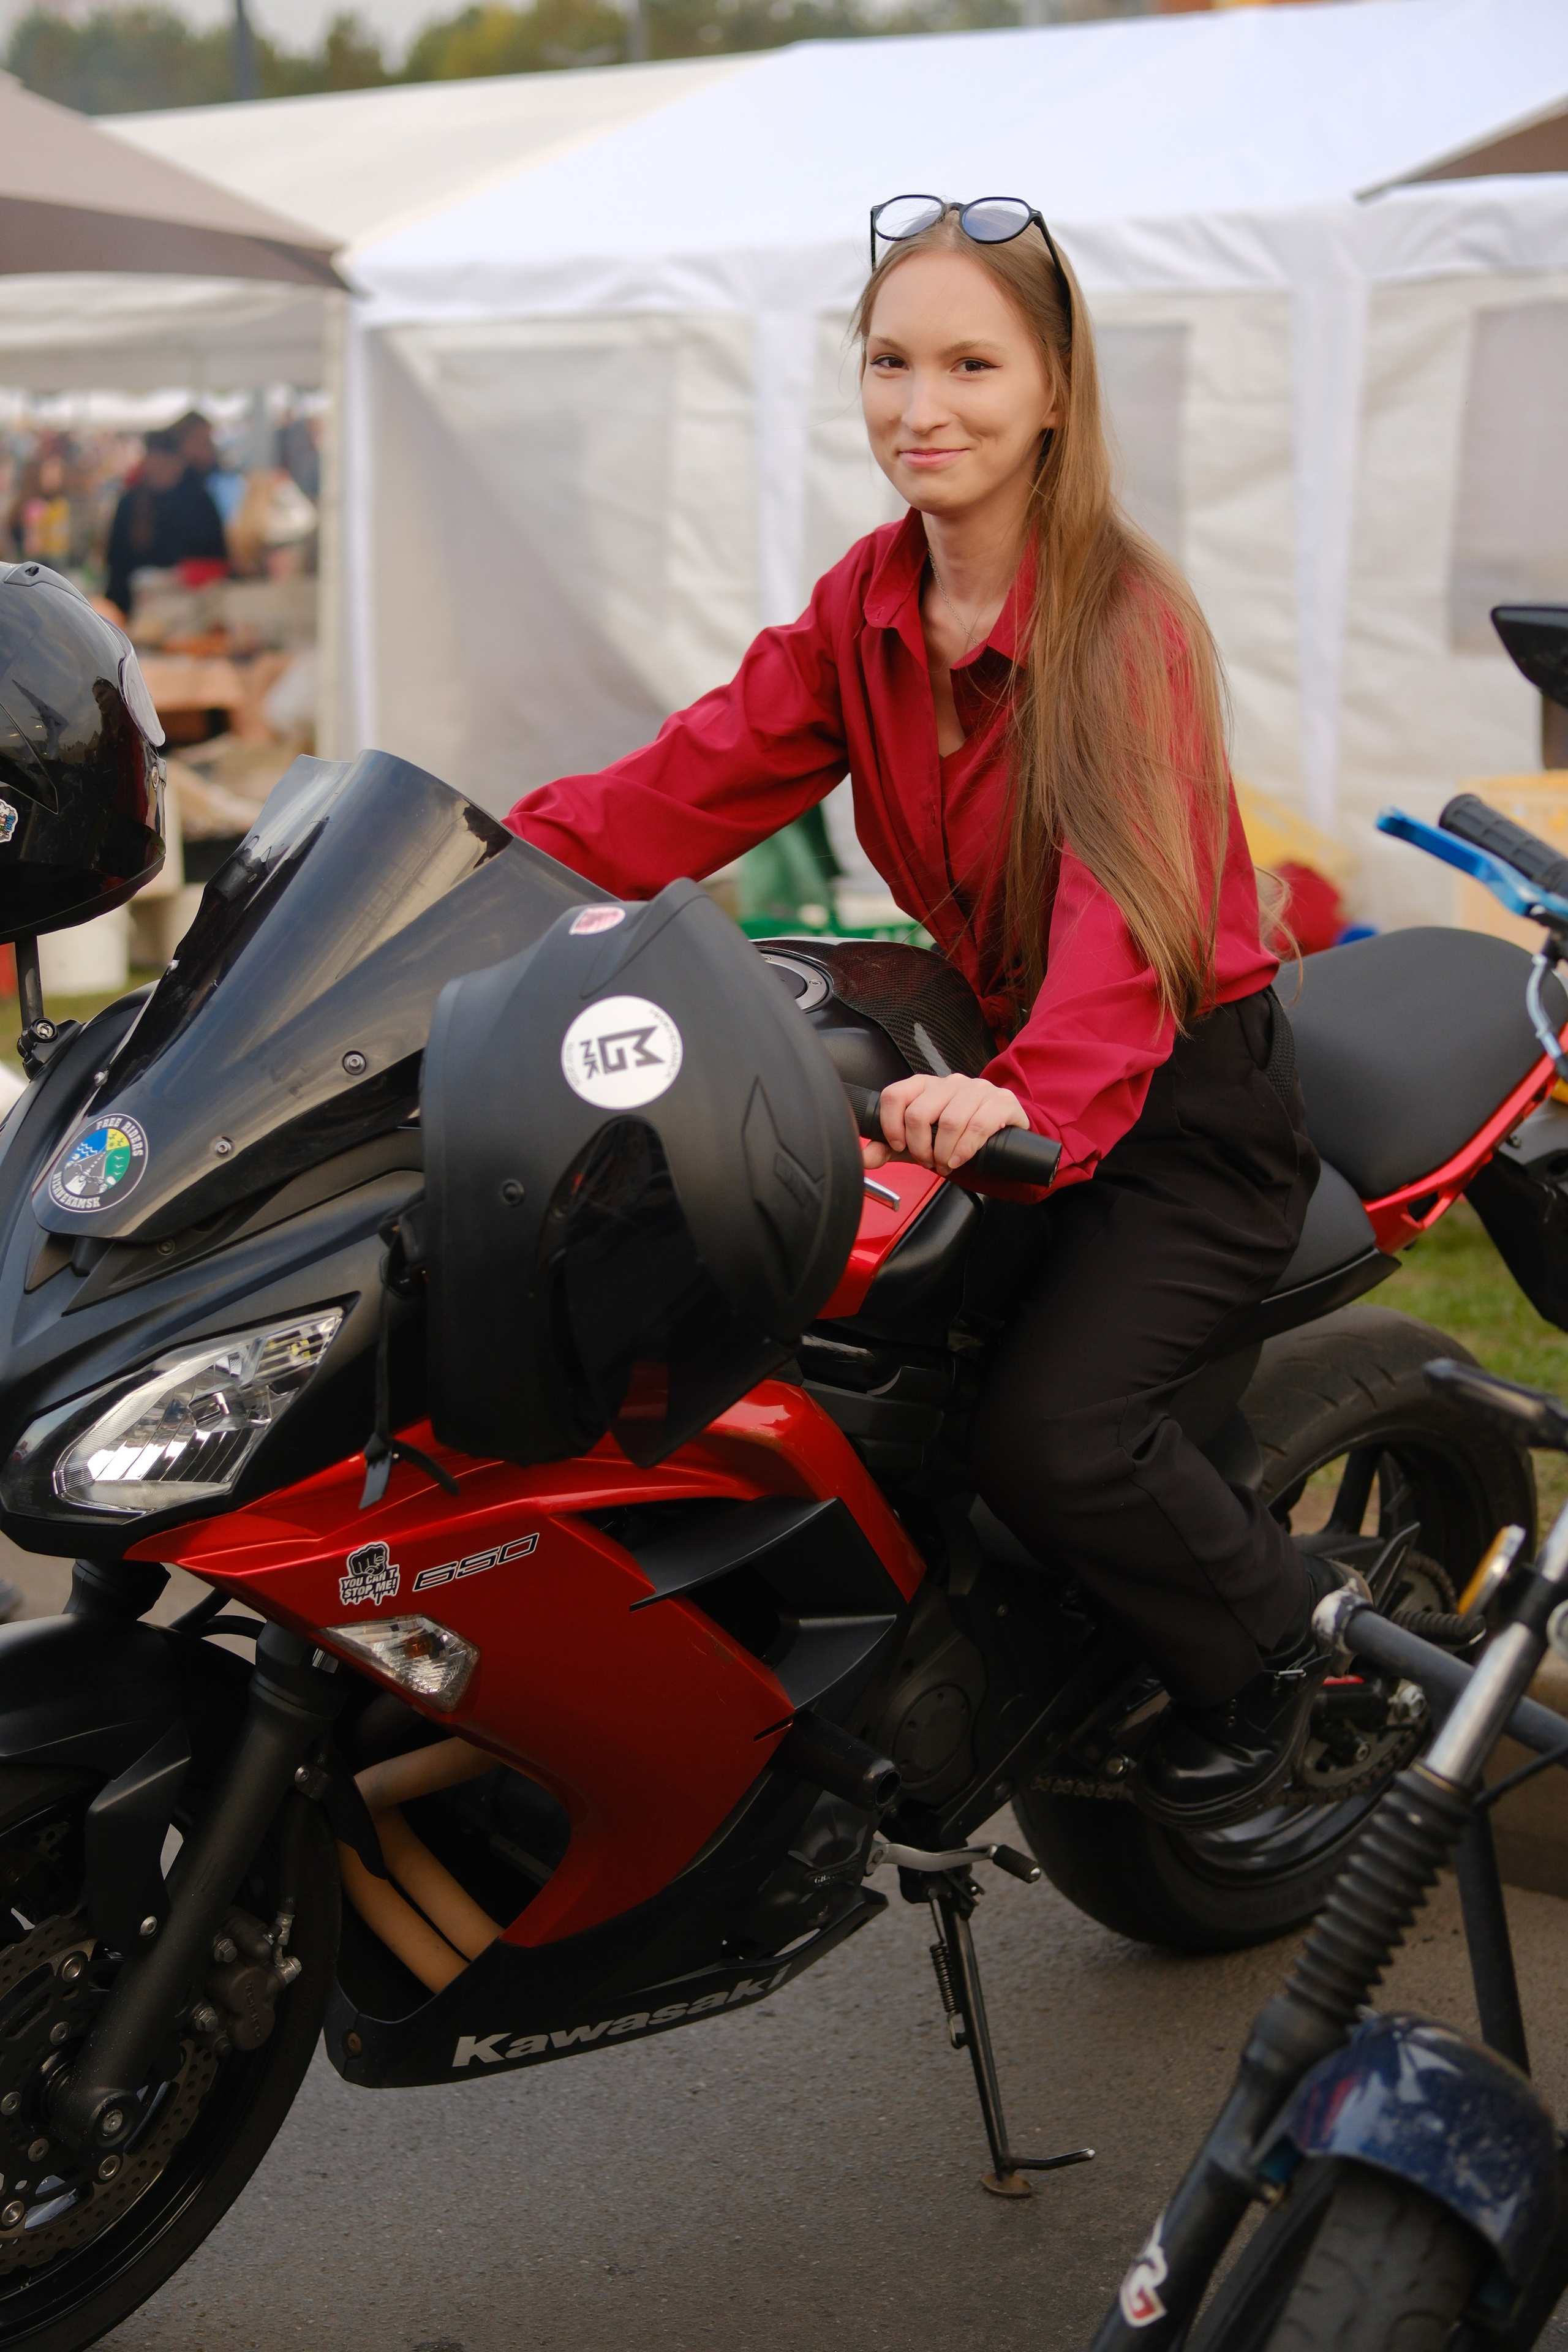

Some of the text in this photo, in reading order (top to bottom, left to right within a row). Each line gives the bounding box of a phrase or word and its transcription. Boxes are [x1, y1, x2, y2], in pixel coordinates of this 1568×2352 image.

[96, 1117, 143, 1156] FREE RIDERS
[51, 1171, 100, 1209] NIZHNEKAMSK
[412, 1532, 540, 1592] 650
[343, 1578, 396, 1598] STOP ME!
[344, 1577, 363, 1589] YOU
[451, 1963, 792, 2067] Kawasaki
